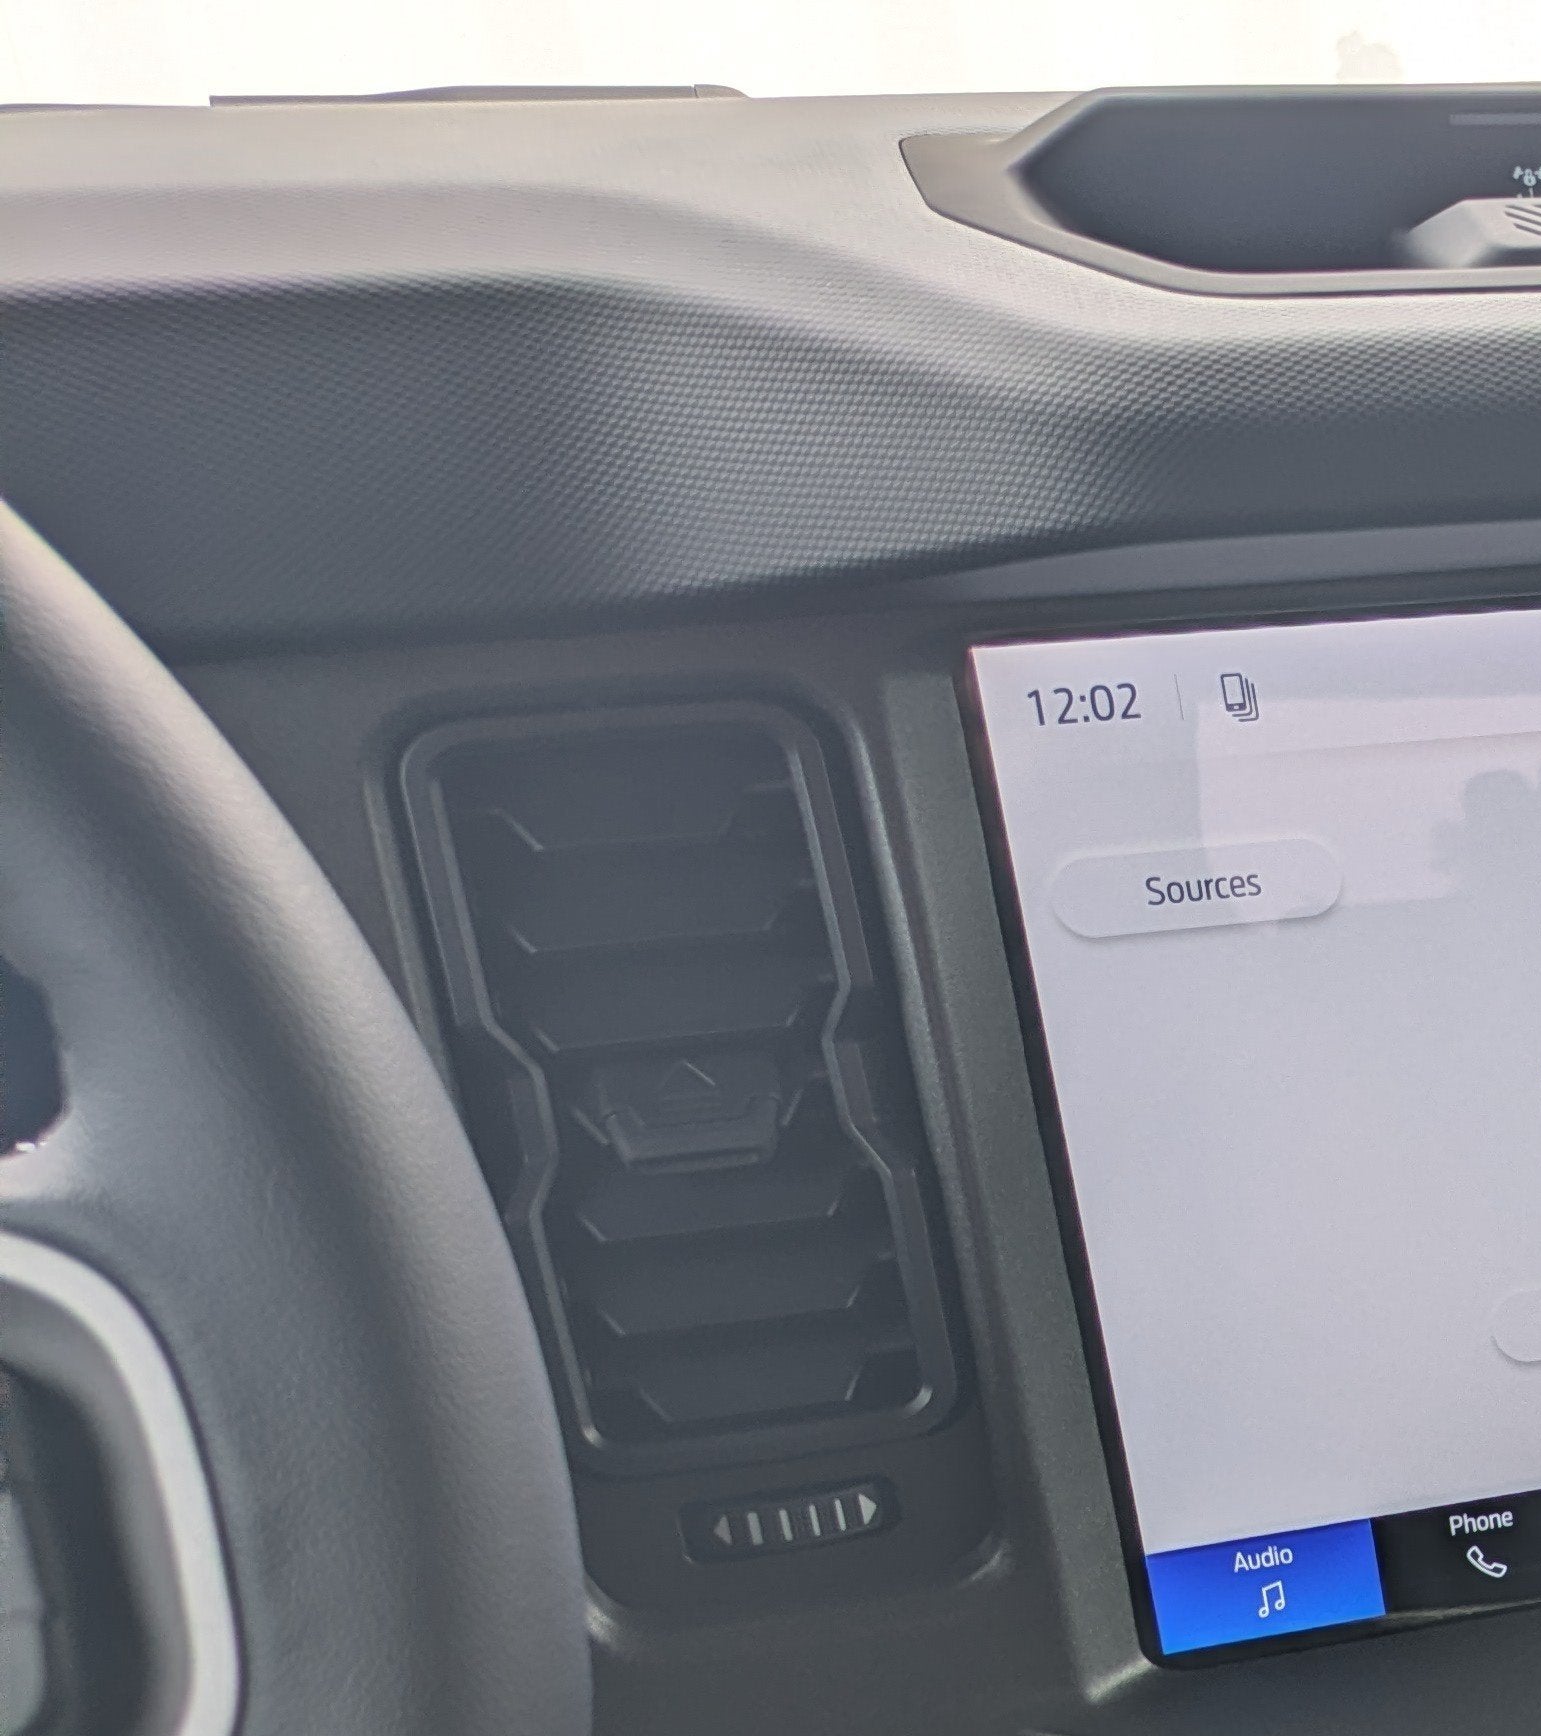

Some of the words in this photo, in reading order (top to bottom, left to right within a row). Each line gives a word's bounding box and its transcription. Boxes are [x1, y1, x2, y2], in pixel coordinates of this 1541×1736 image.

[1026, 682, 1143, 728] 12:02
[1145, 868, 1263, 908] Sources
[1448, 1507, 1515, 1539] Phone
[1232, 1544, 1294, 1573] Audio
